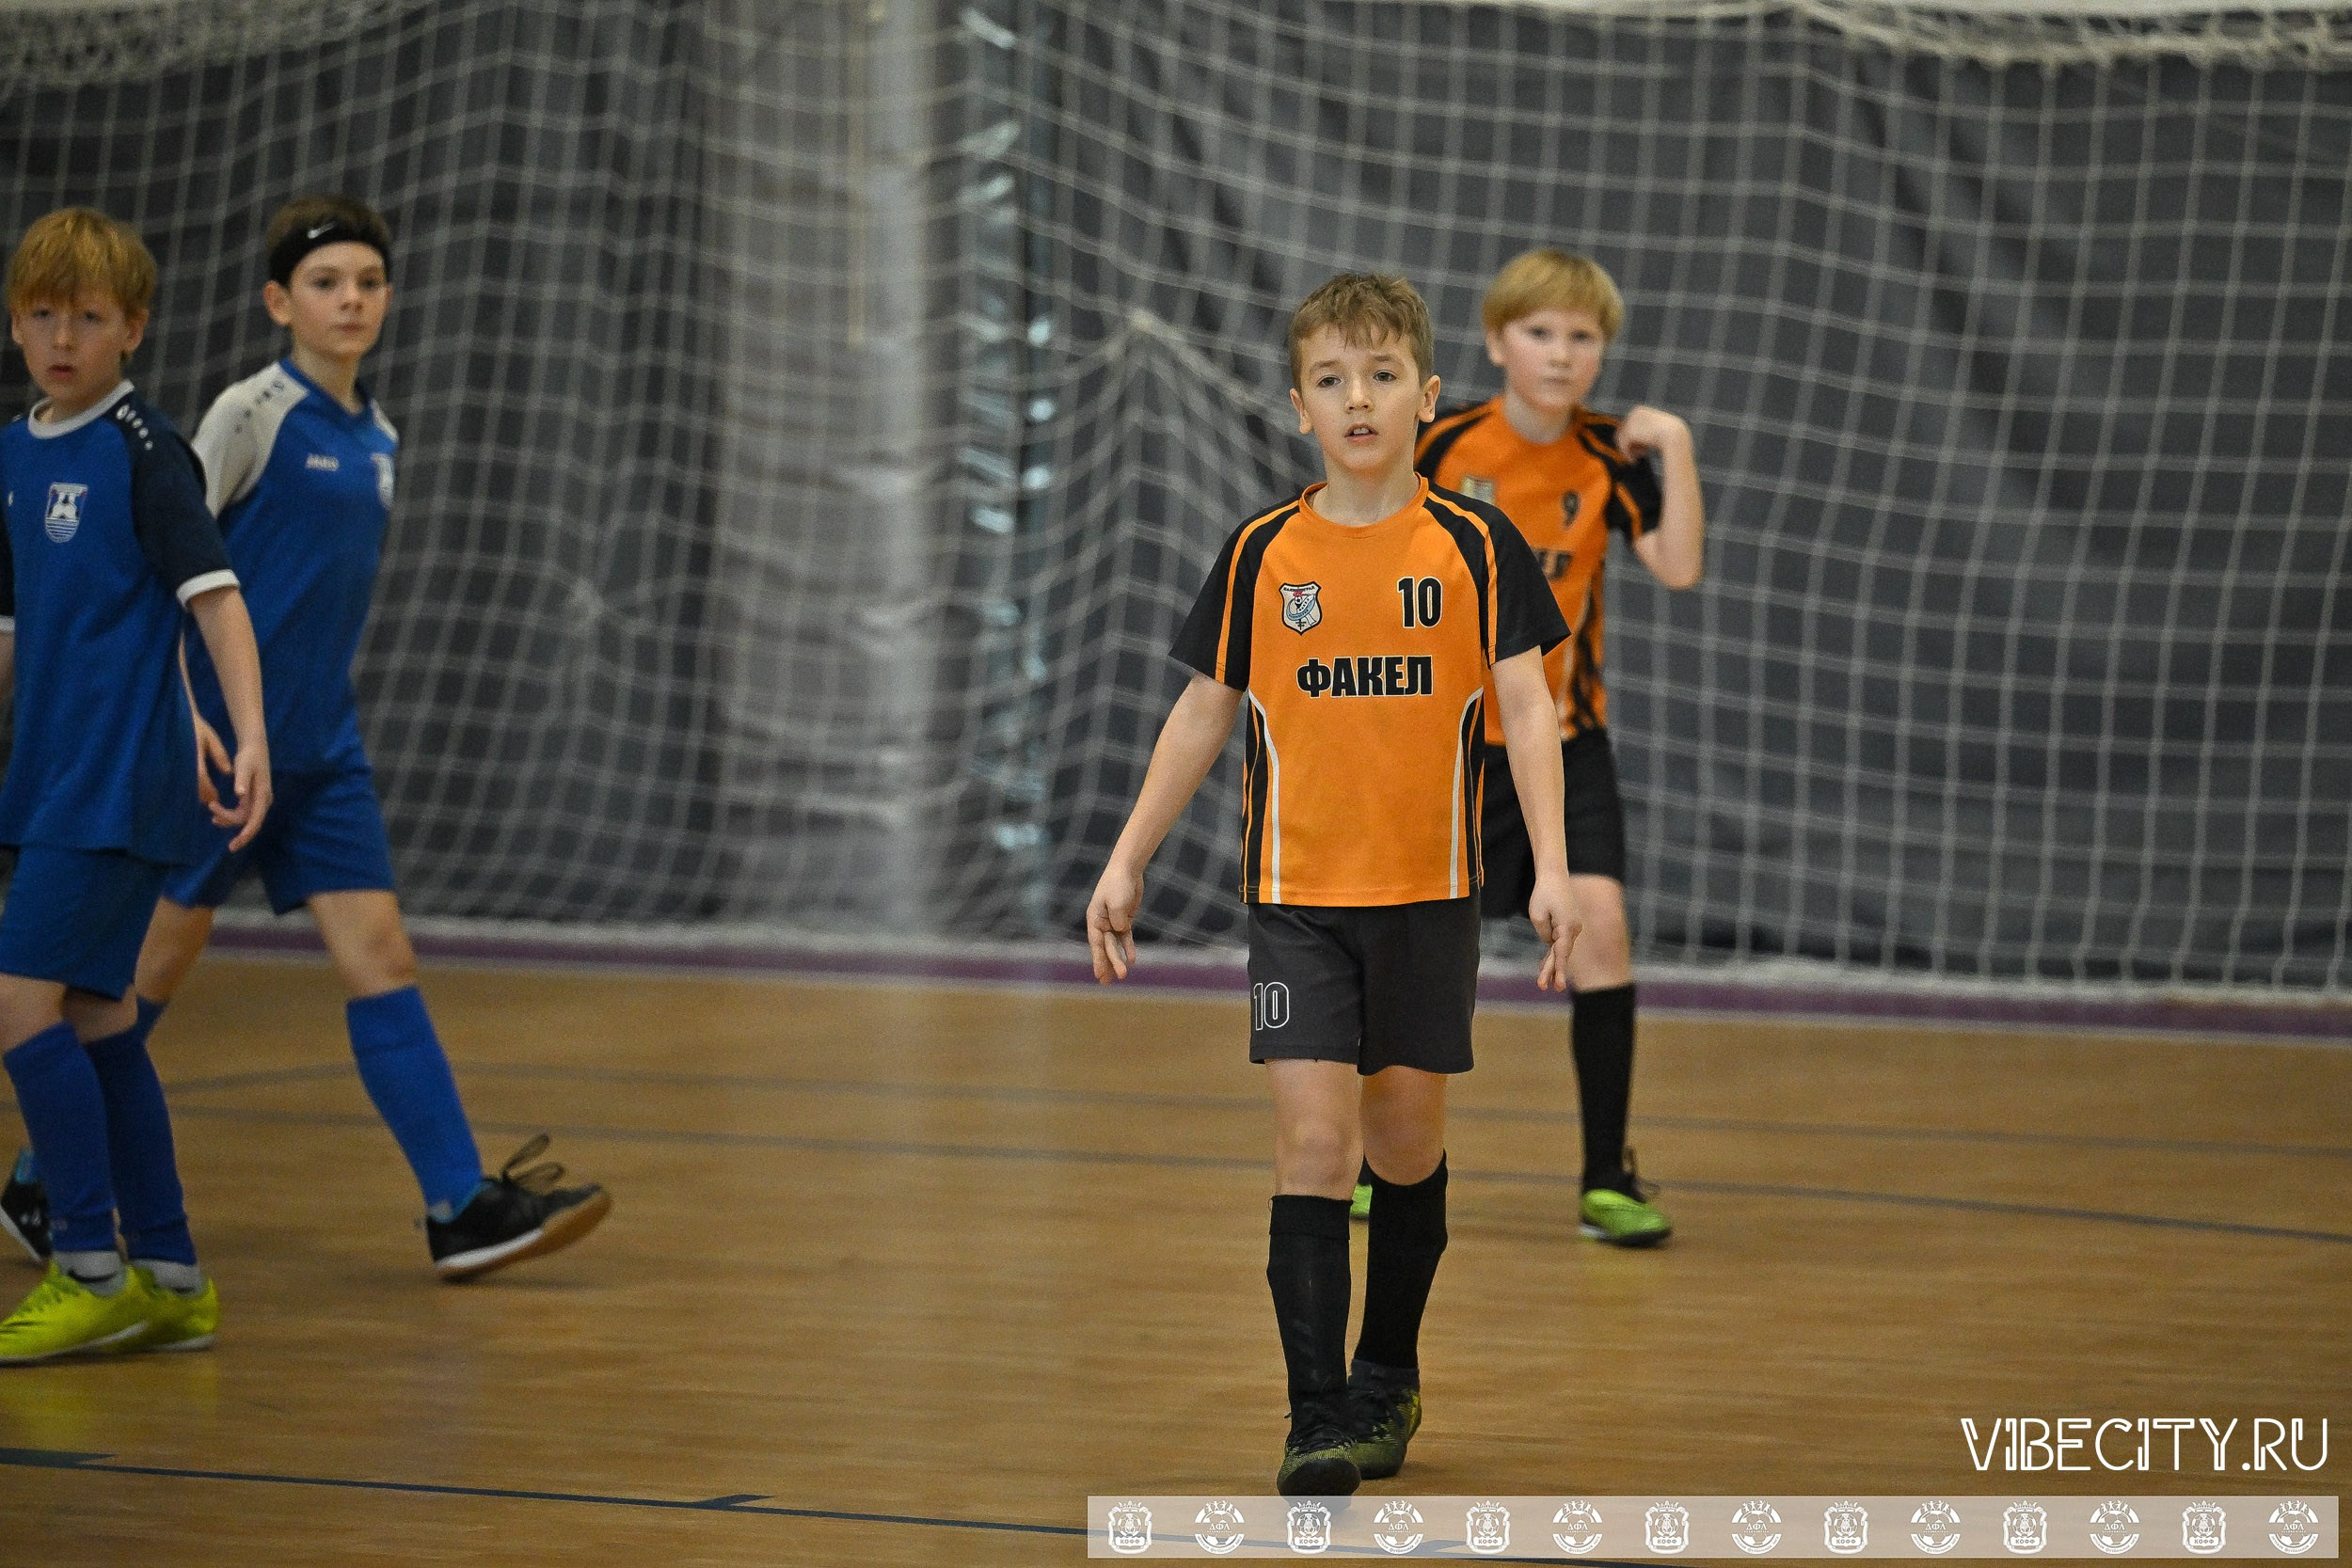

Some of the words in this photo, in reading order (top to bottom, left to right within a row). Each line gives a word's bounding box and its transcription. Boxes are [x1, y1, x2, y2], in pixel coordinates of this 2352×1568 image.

[1563, 490, 1579, 527] 9
[1397, 576, 1442, 628] 10
[1295, 655, 1433, 699] ФАКЕЛ
[1253, 981, 1290, 1031] 10
